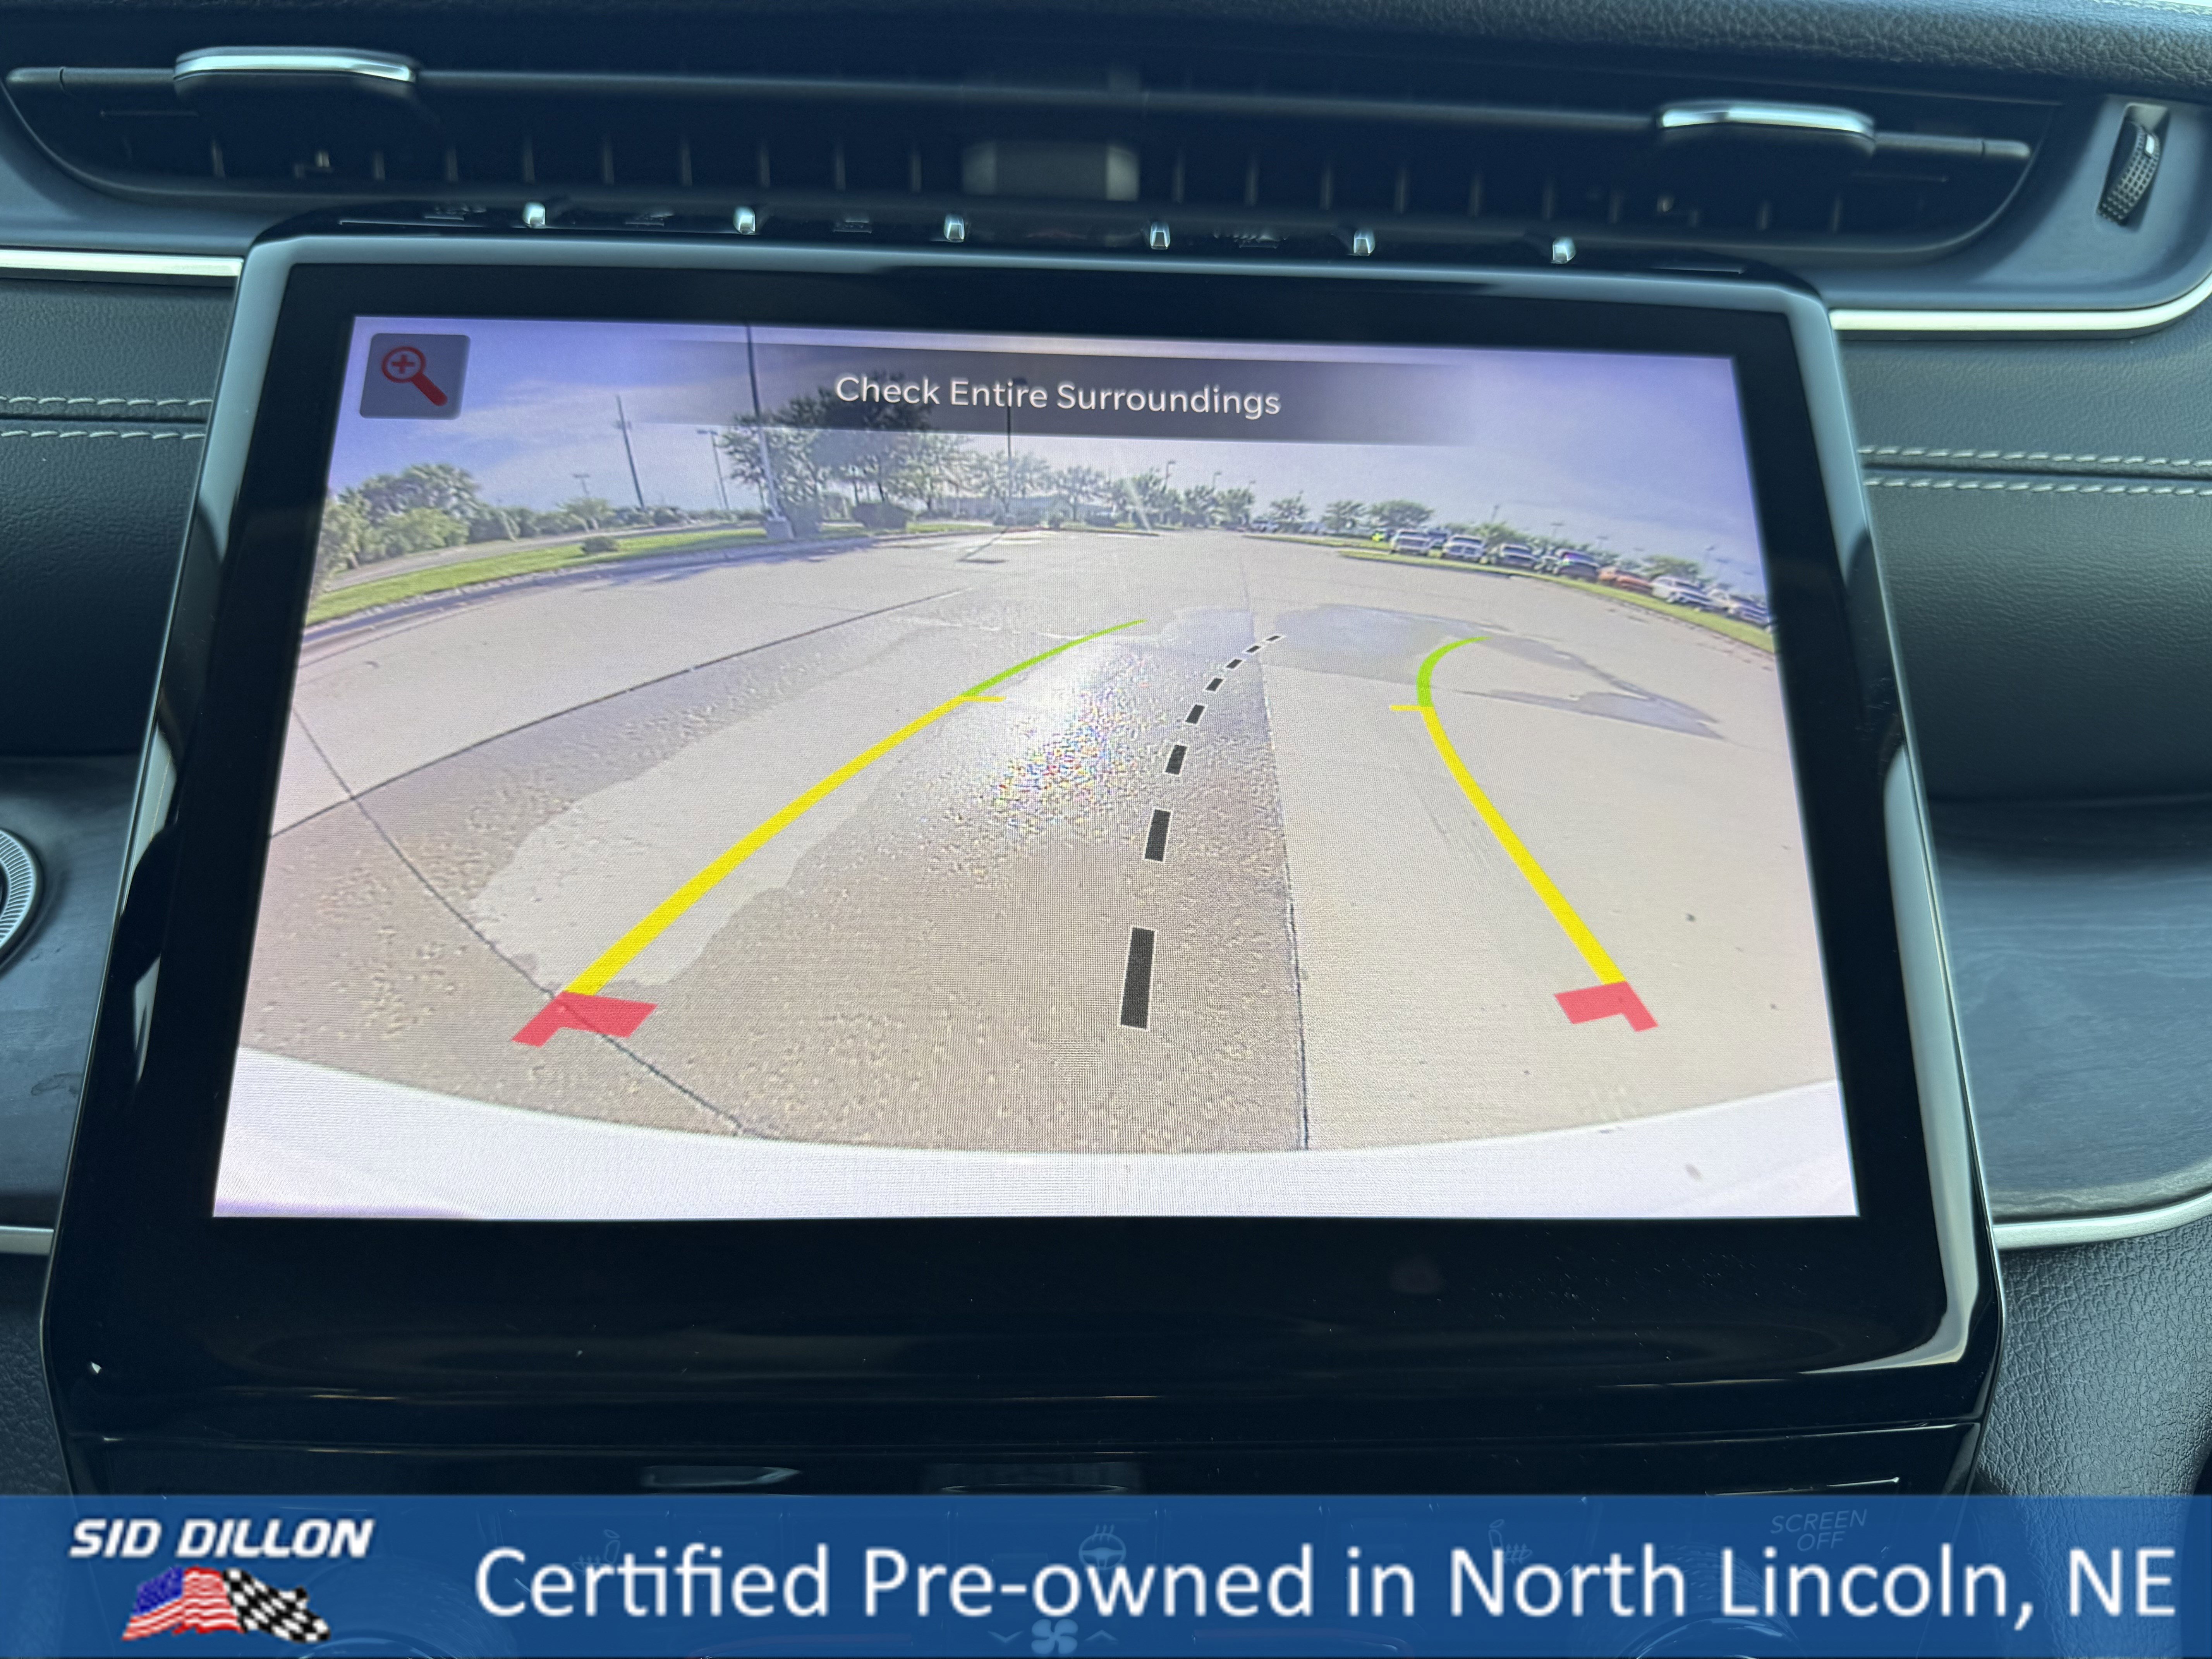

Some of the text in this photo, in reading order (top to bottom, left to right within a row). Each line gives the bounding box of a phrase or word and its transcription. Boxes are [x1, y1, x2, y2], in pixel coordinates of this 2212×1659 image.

[835, 375, 1281, 421] Check Entire Surroundings
[1770, 1509, 1868, 1534] SCREEN
[1796, 1531, 1846, 1552] OFF
